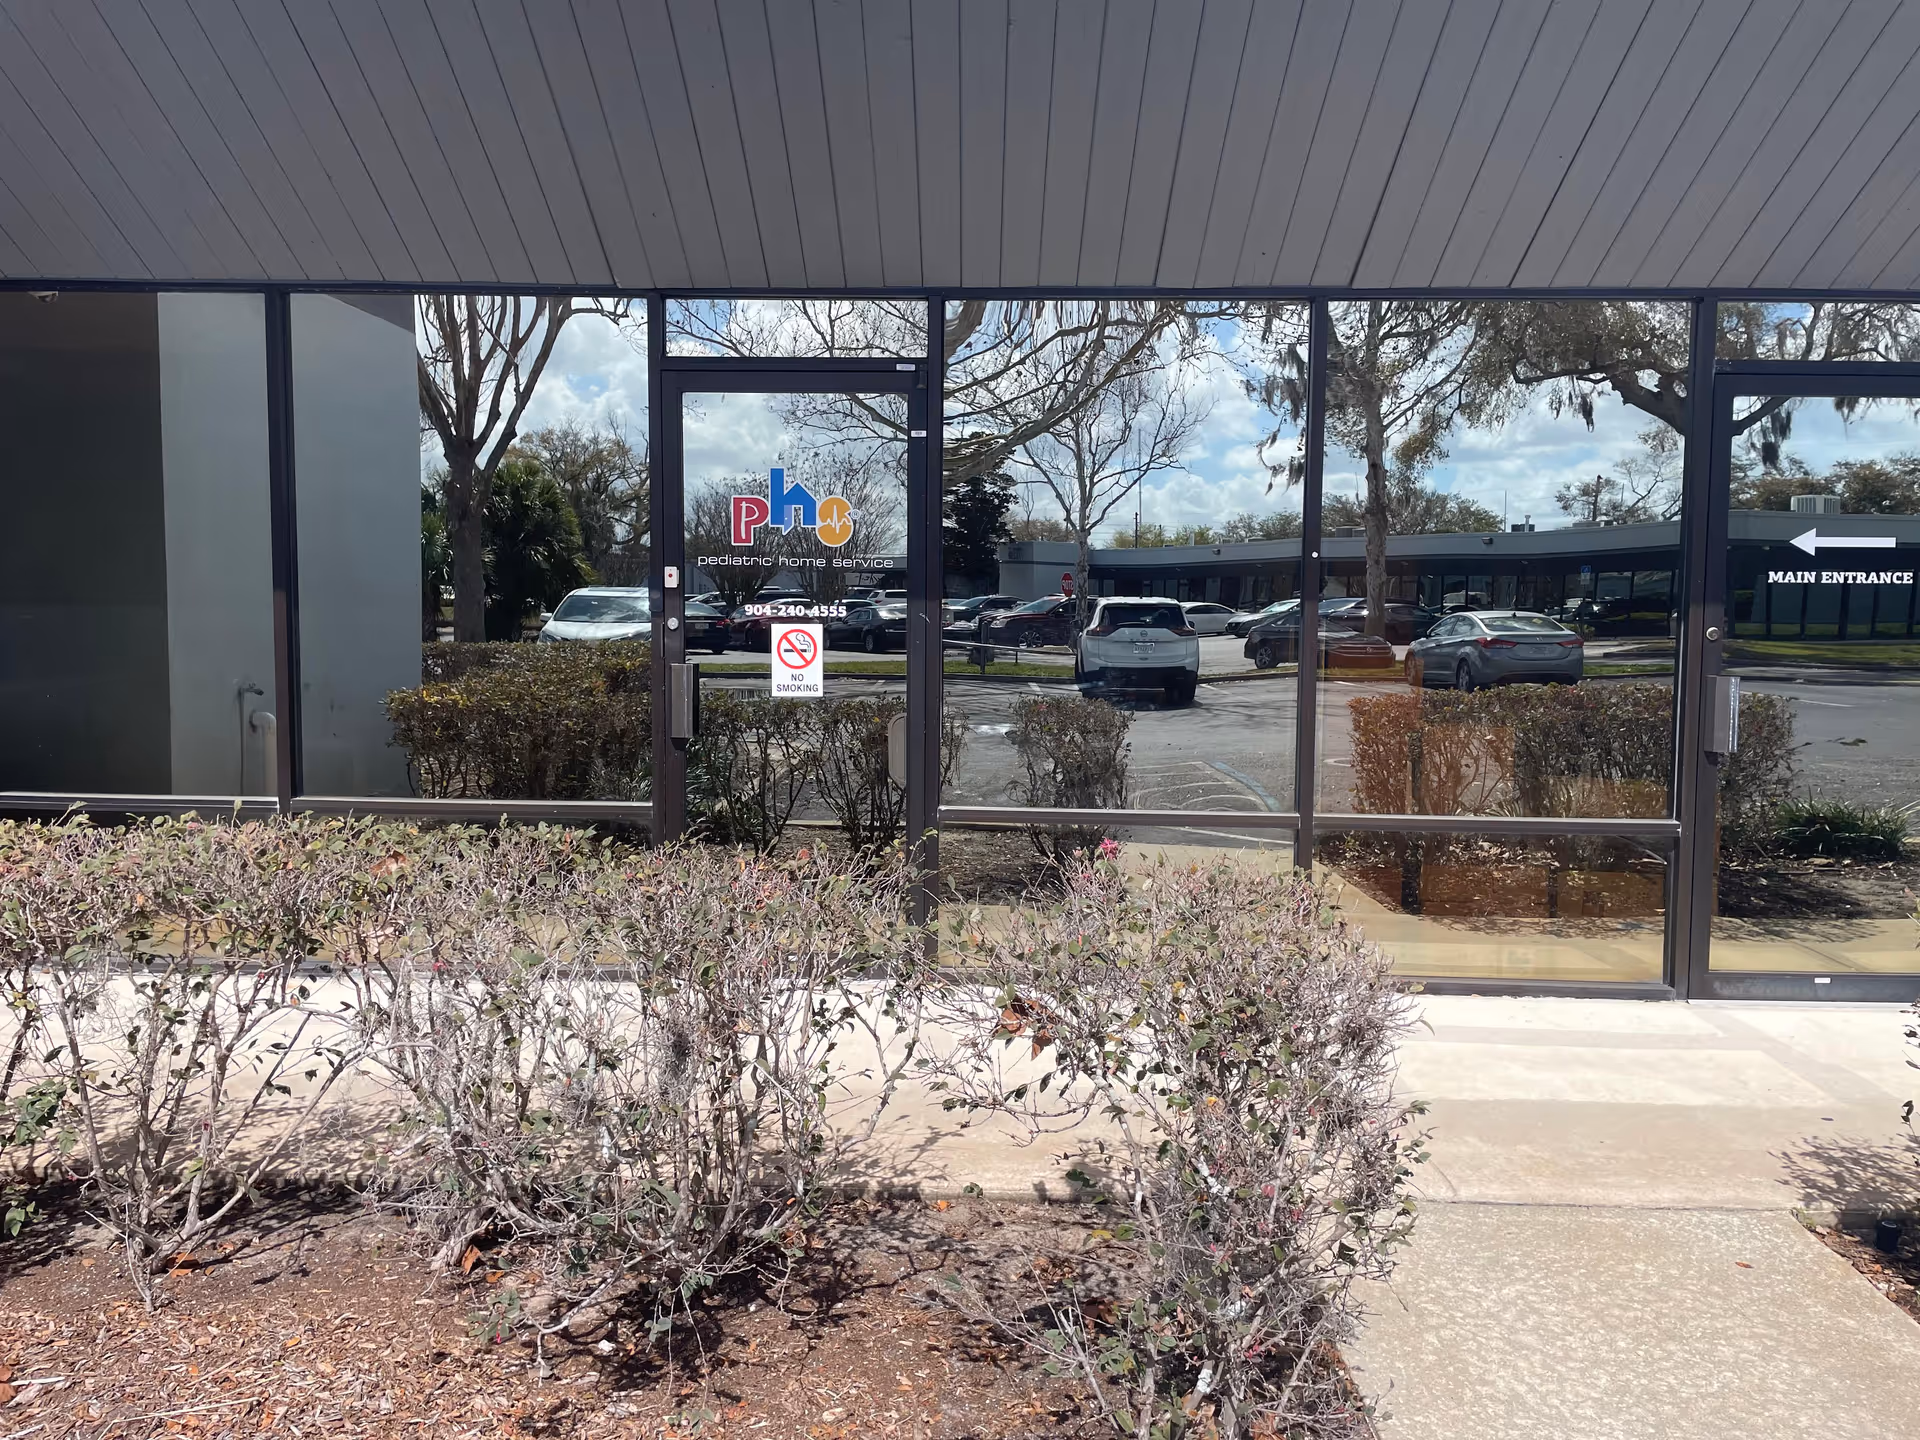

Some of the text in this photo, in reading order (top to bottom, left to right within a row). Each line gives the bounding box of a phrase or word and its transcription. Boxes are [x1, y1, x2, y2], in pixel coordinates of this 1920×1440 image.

[697, 554, 894, 568] pediatric home service
[1768, 571, 1914, 585] MAIN ENTRANCE
[744, 604, 847, 617] 904-240-4555
[791, 673, 804, 682] NO
[776, 684, 819, 692] SMOKING
